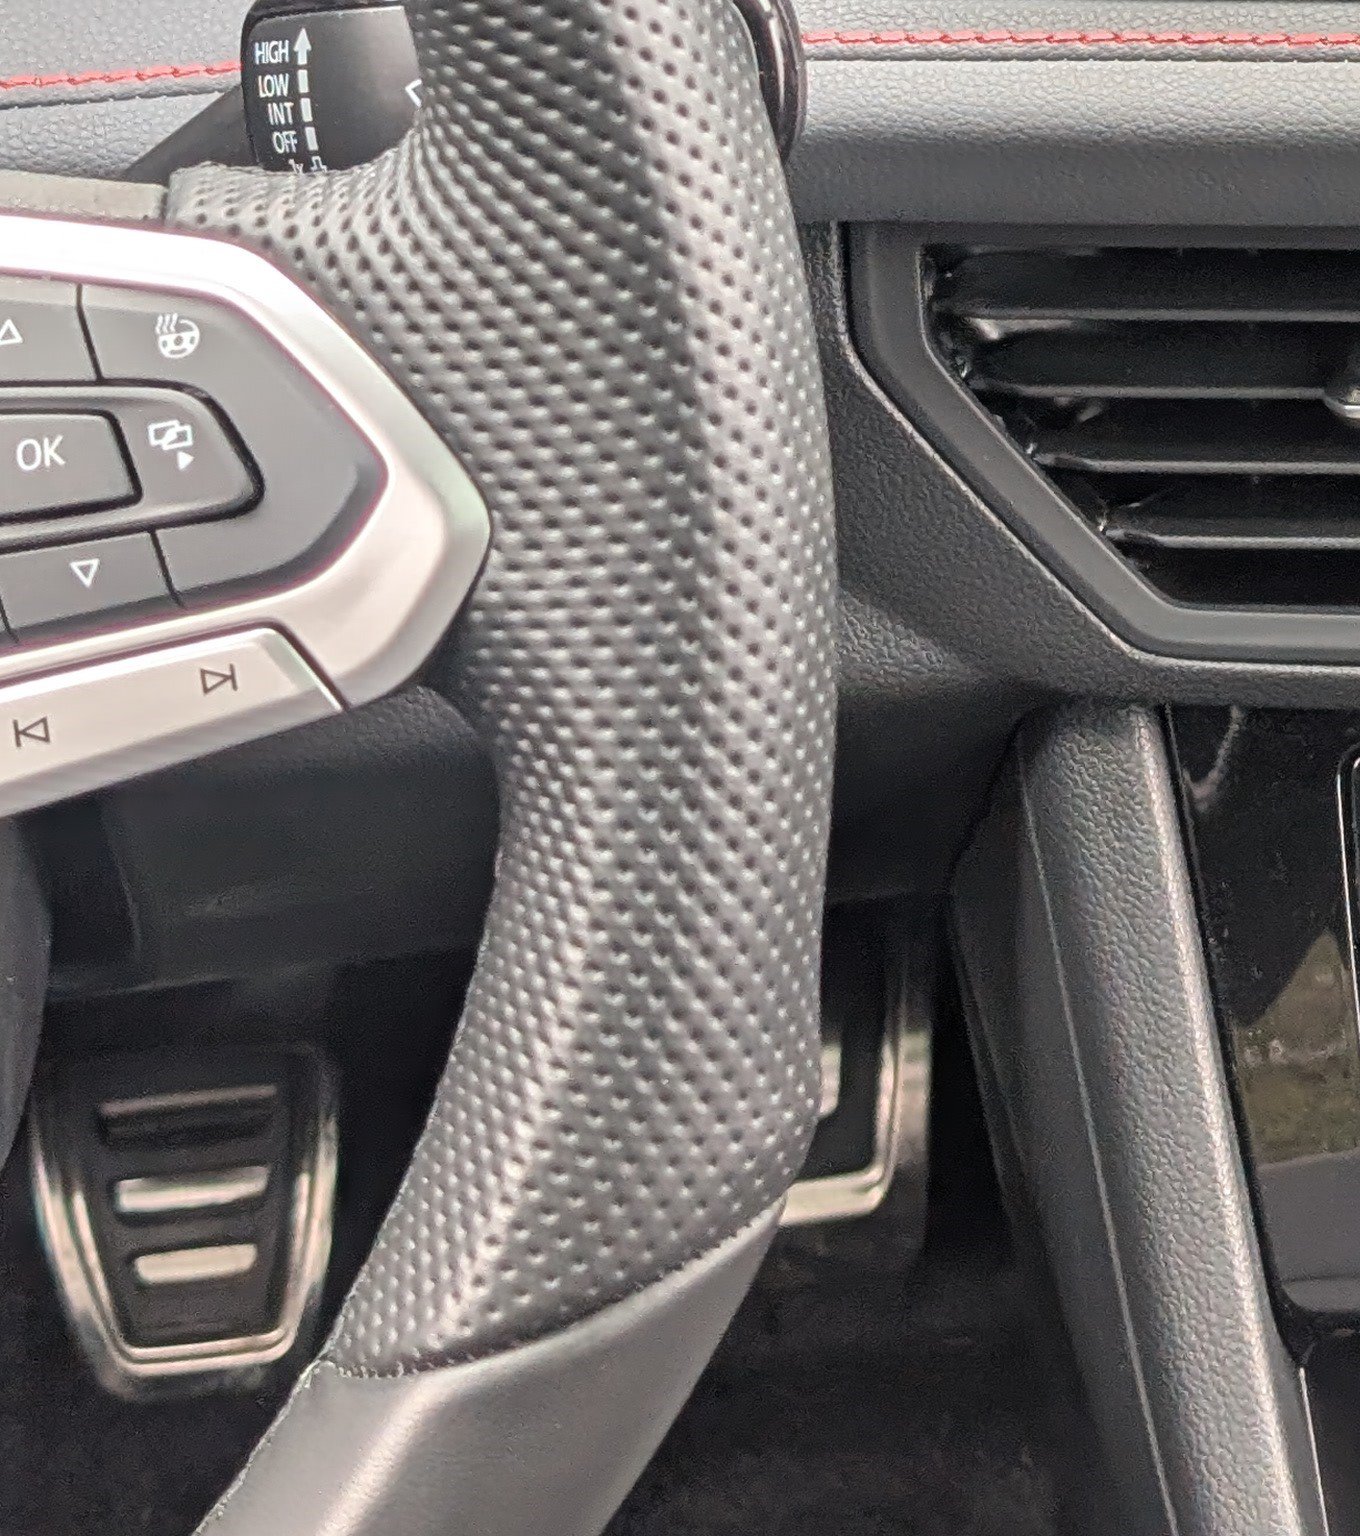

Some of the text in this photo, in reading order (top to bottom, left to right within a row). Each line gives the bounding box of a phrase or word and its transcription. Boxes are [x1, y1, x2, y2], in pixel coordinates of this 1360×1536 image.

[254, 40, 290, 64] HIGH
[258, 73, 290, 98] LOW
[267, 101, 294, 125] INT
[272, 130, 298, 154] OFF
[16, 434, 66, 472] OK
